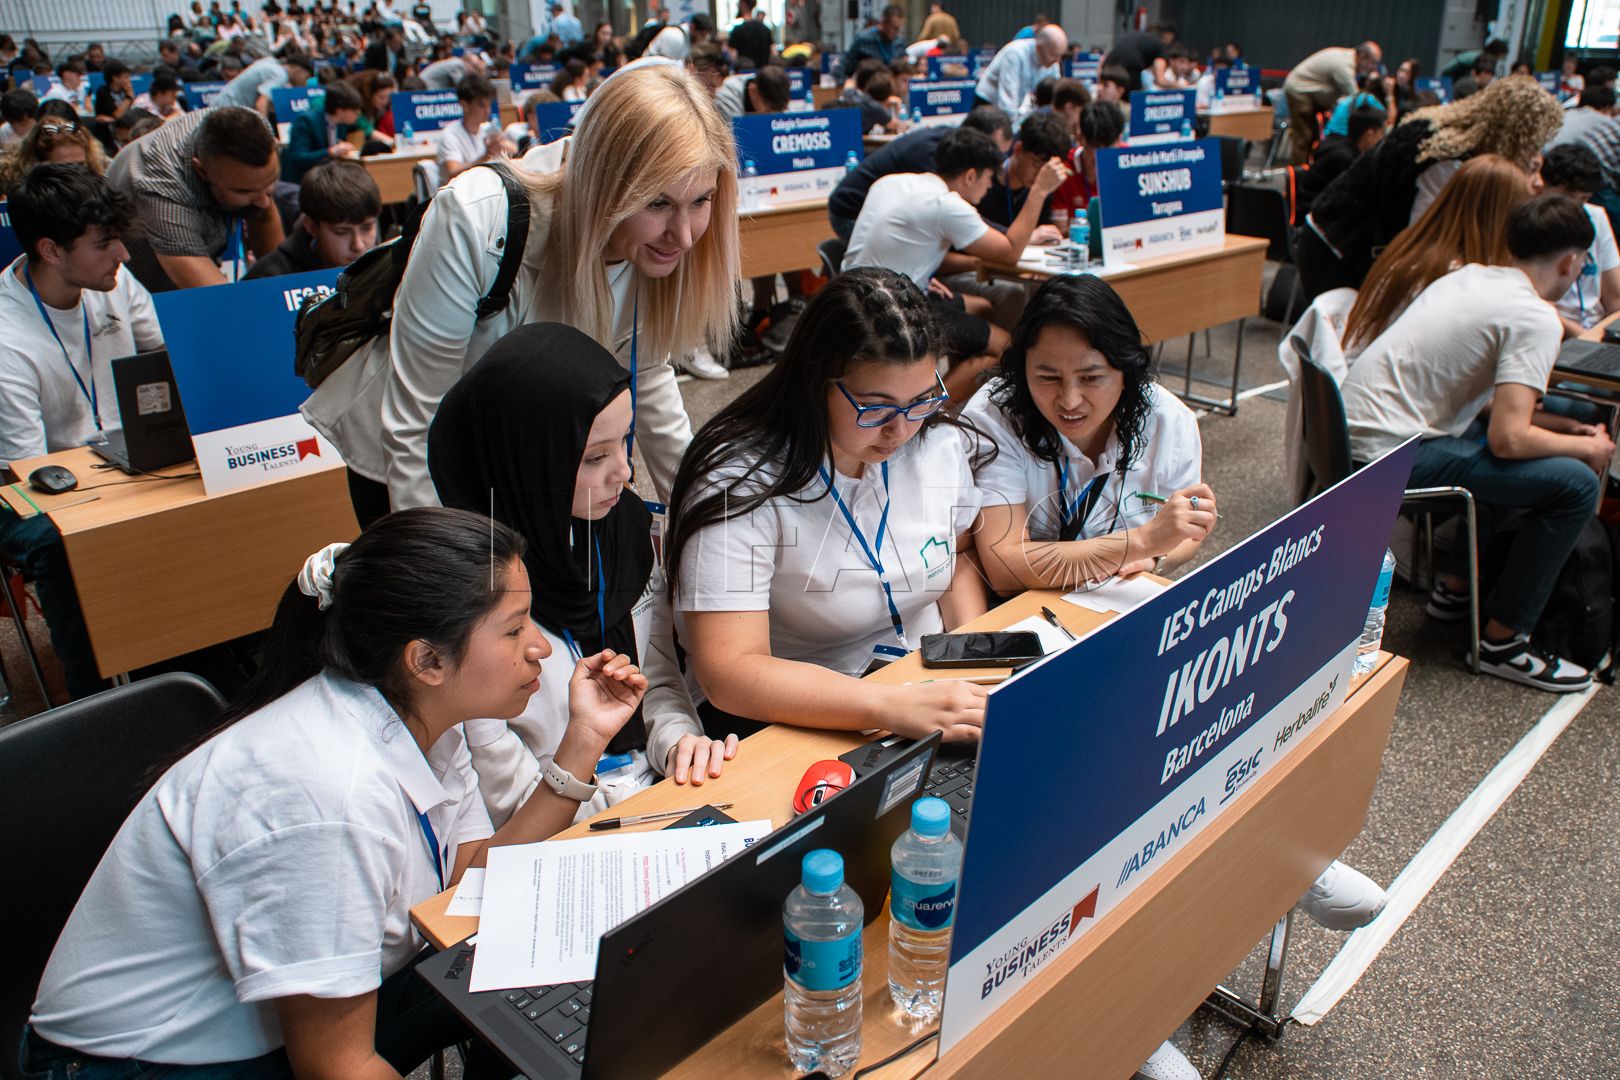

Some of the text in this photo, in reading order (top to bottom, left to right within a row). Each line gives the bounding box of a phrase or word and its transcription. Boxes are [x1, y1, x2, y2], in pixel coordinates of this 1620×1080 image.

[772, 131, 831, 154] CREMOSIS
[1138, 168, 1192, 196] SUNSHUB
[228, 444, 296, 470] BUSINESS
[1157, 525, 1325, 656] IES Camps Blancs
[1155, 590, 1295, 738] IKONTS
[1160, 692, 1255, 785] Barcelona
[1273, 691, 1330, 752] Herbalife
[981, 913, 1070, 1000] BUSINESS
[986, 937, 1027, 975] YOUNG
[1021, 936, 1066, 978] TALENTS
